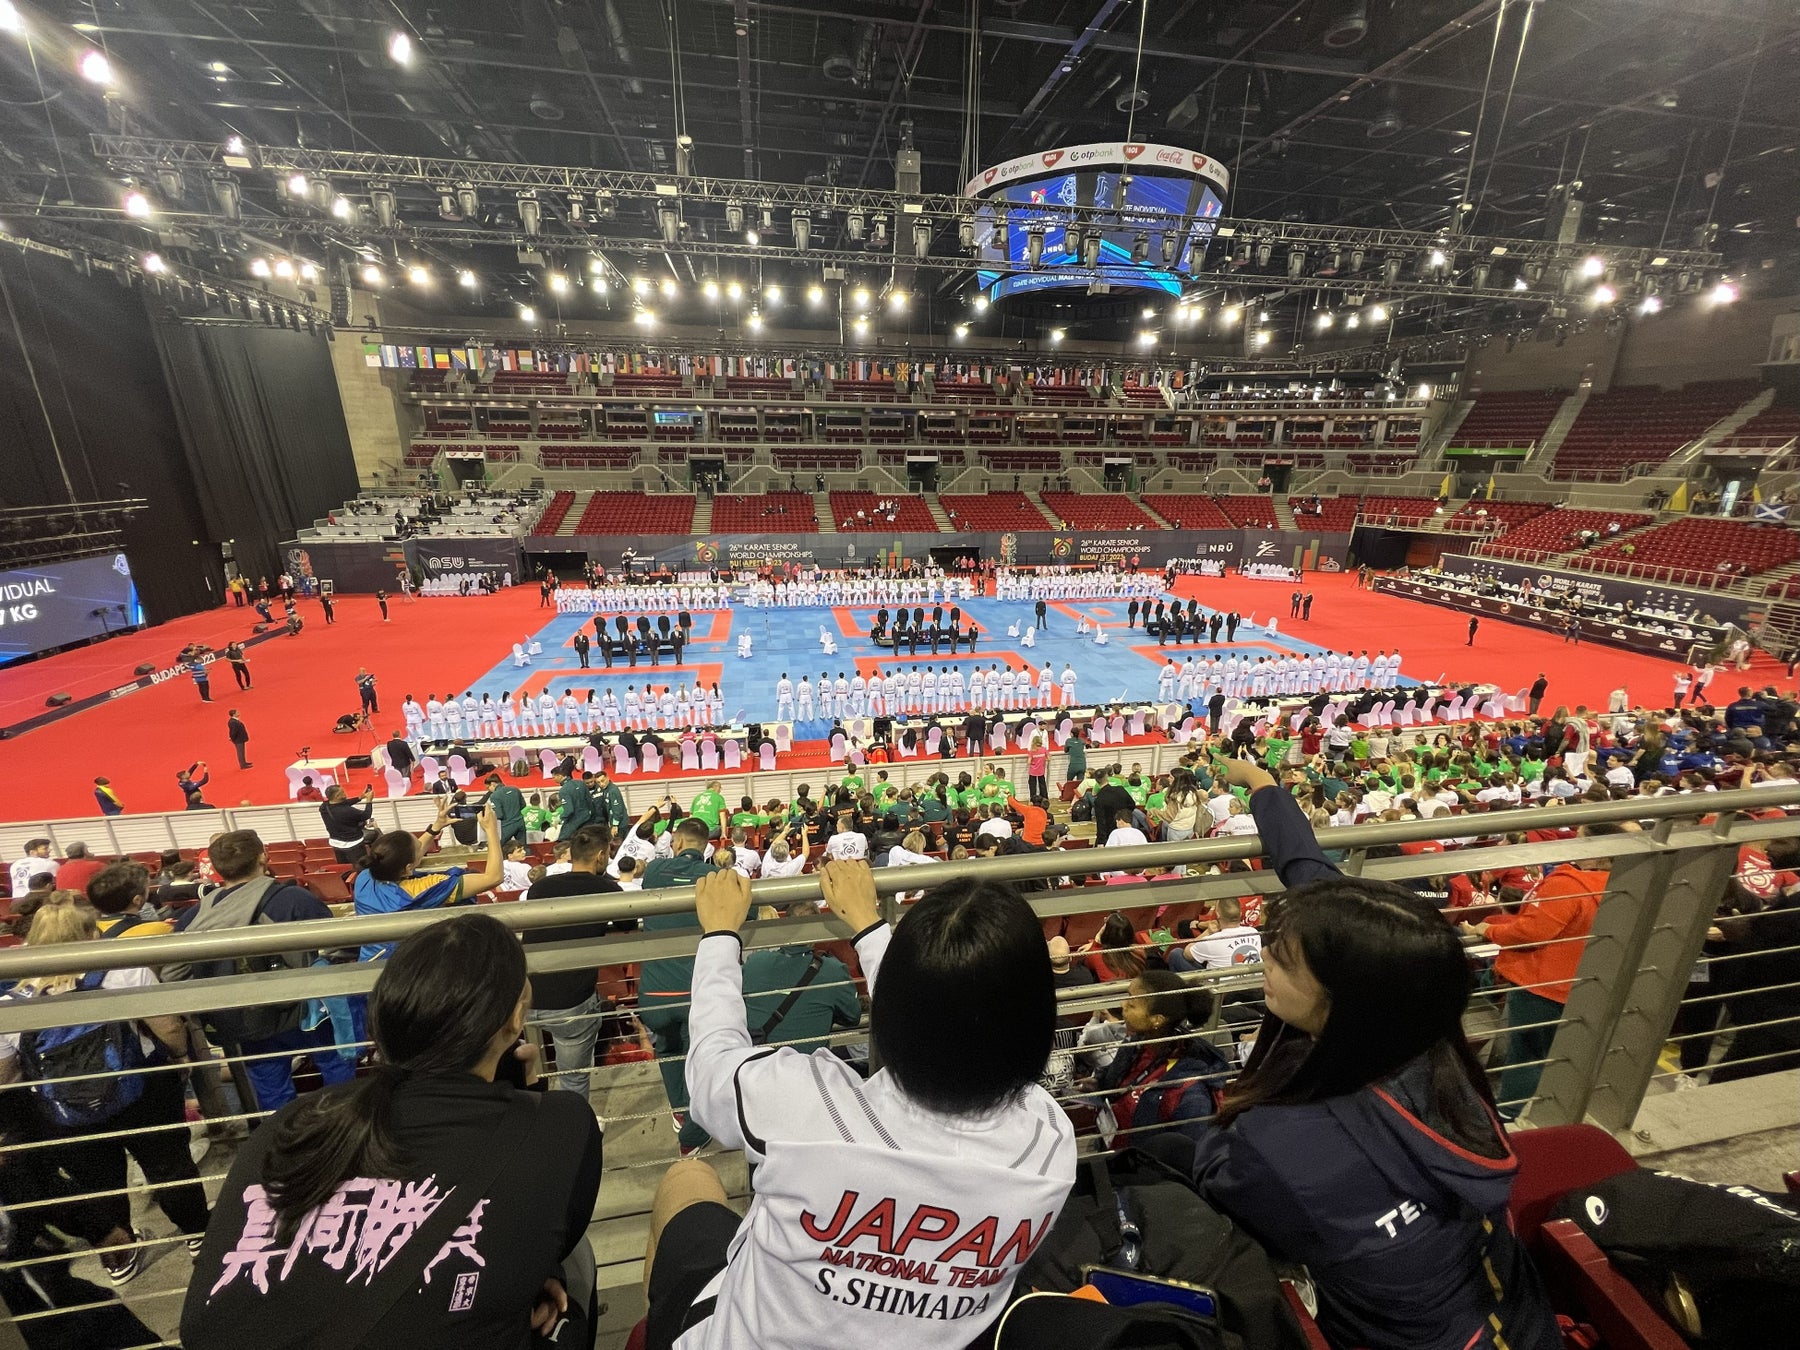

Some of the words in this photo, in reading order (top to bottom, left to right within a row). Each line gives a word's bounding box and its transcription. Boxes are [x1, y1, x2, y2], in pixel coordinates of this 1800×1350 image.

[744, 543, 771, 551] KARATE
[772, 543, 798, 551] SENIOR
[756, 551, 814, 559] CHAMPIONSHIPS
[1103, 546, 1151, 554] CHAMPIONSHIPS
[0, 578, 56, 602] IDUAL
[1575, 581, 1602, 591] KARATE
[9, 603, 37, 622] KG
[1227, 937, 1258, 950] TAHITI
[799, 1190, 1054, 1268] JAPAN
[1375, 1200, 1427, 1239] TE
[819, 1246, 941, 1285] NATIONAL
[947, 1267, 1008, 1289] TEAM
[814, 1267, 990, 1322] S.SHIMADA
